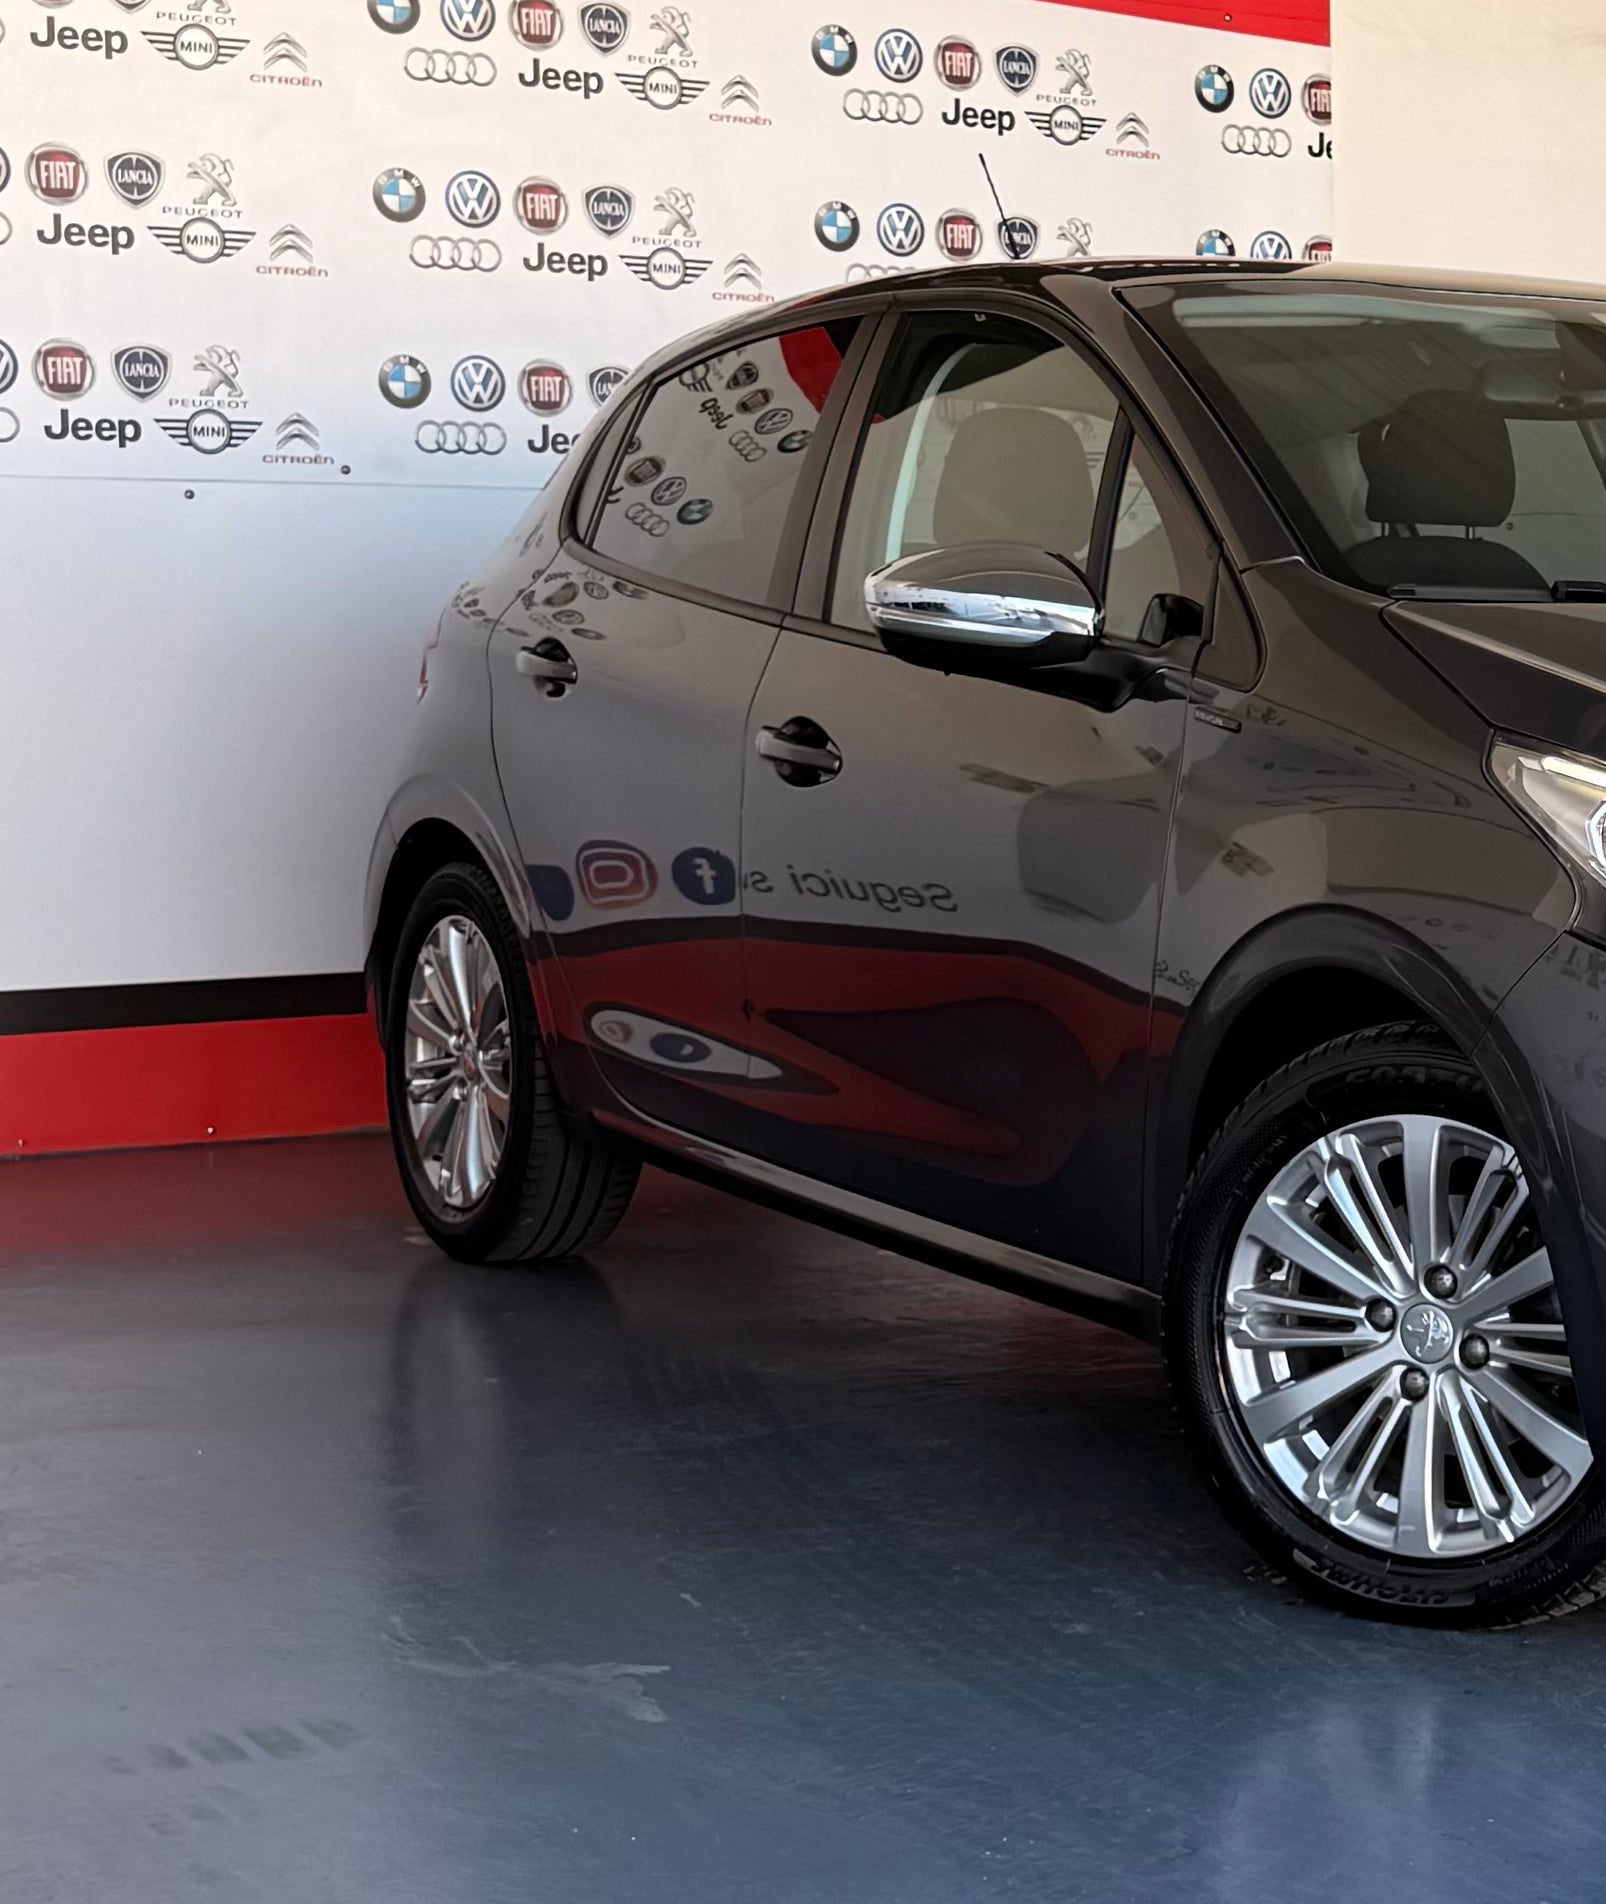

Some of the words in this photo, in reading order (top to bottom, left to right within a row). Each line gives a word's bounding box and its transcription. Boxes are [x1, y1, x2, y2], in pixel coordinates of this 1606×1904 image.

[156, 10, 237, 27] PEUGEOT
[521, 10, 554, 36] FIAT
[29, 15, 129, 59] Jeep
[180, 40, 213, 55] MINI
[627, 54, 700, 70] PEUGEOT
[944, 52, 975, 77] FIAT
[518, 58, 605, 99] Jeep
[648, 81, 678, 96] MINI
[1035, 93, 1099, 107] PEUGEOT
[941, 98, 1015, 135] Jeep
[1052, 118, 1080, 133] MINI
[40, 160, 77, 190] FIAT
[116, 168, 154, 187] LANCIA
[162, 205, 244, 220] PEUGEOT
[526, 192, 558, 221] FIAT
[37, 213, 136, 256] Jeep
[186, 234, 220, 248] MINI
[632, 235, 703, 249] PEUGEOT
[946, 225, 976, 249] FIAT
[523, 242, 609, 282] Jeep
[651, 261, 682, 276] MINI
[47, 356, 84, 386] FIAT
[124, 362, 161, 380] LANCIA
[530, 376, 562, 403] FIAT
[168, 397, 250, 410] PEUGEOT
[44, 408, 142, 448] Jeep
[193, 426, 226, 439] MINI
